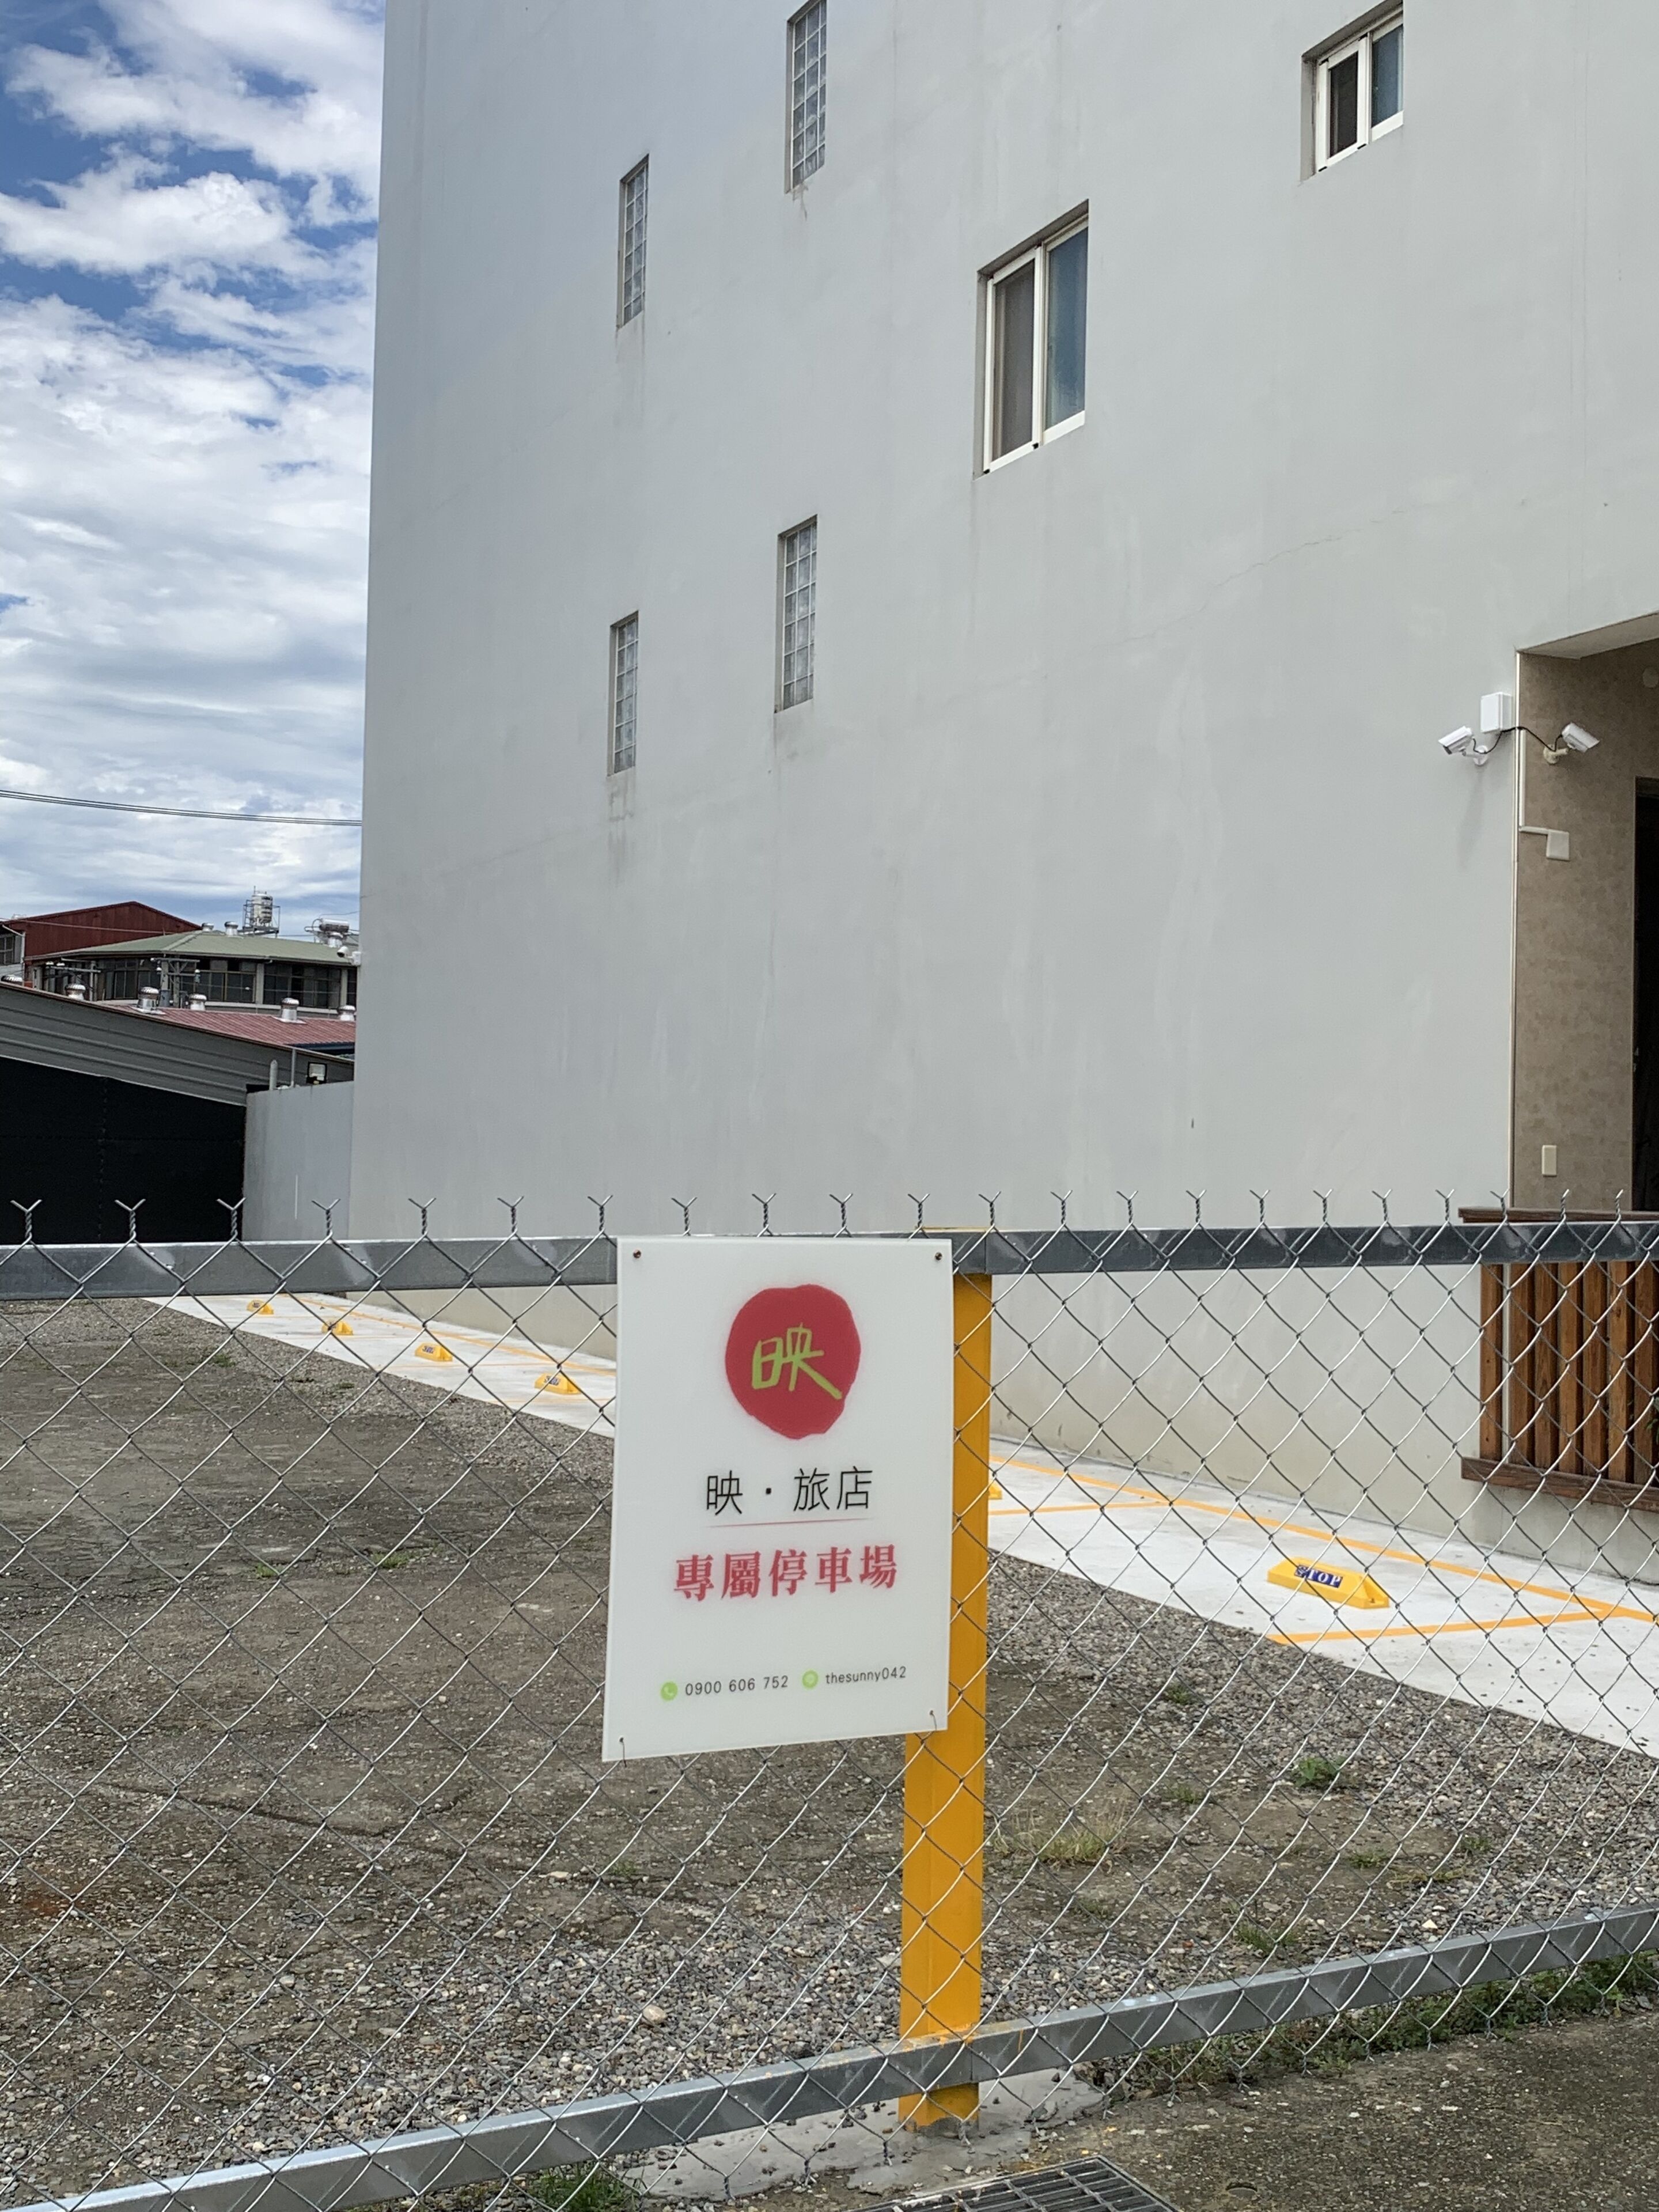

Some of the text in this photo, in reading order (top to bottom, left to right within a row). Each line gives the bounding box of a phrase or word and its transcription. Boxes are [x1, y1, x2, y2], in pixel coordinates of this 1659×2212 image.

[751, 1323, 842, 1400] 映
[673, 1544, 897, 1602] 專屬停車場
[1296, 1566, 1342, 1586] STOP
[684, 1666, 907, 1696] 0900 606 752 thesunny042
